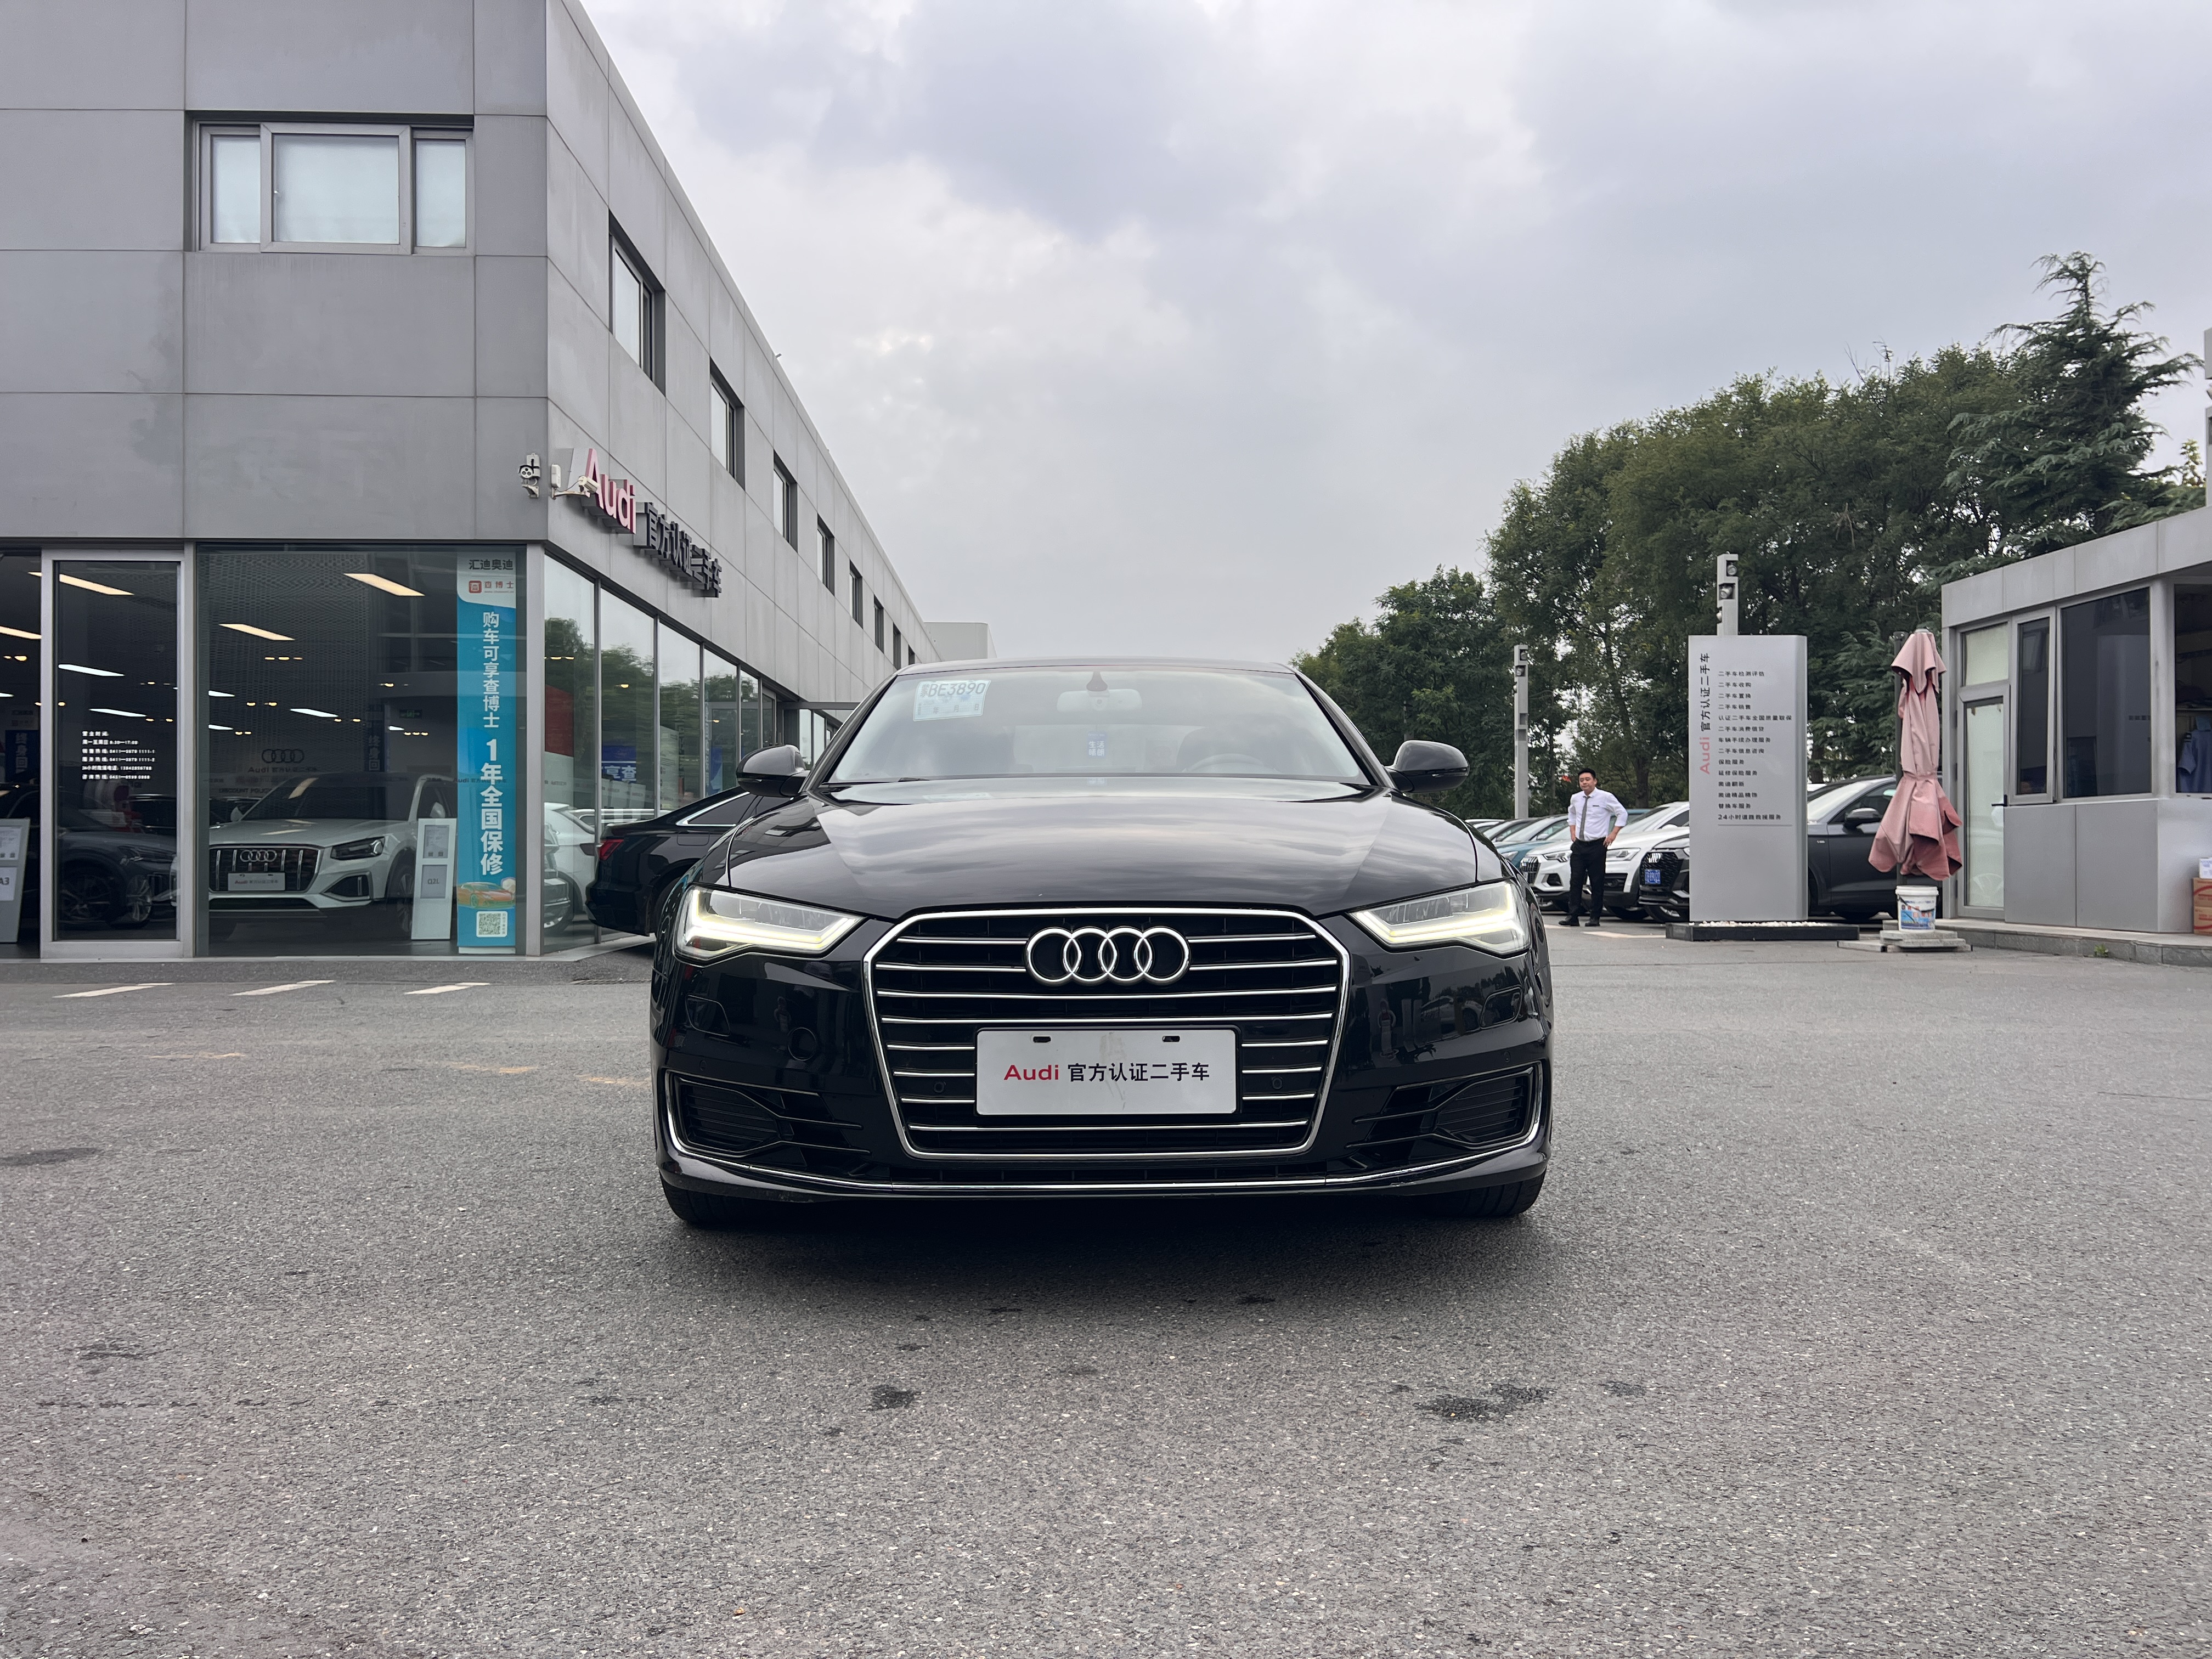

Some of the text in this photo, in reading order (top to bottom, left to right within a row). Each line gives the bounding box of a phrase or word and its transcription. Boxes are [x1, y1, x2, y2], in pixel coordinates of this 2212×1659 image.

[469, 559, 514, 570] 汇迪奥迪
[585, 448, 723, 598] Audi 官方认证二手车
[483, 611, 499, 729] 购车可享查博士
[1700, 653, 1711, 775] Audi 官方认证二手车
[481, 738, 503, 876] 1年全国保修
[1003, 1062, 1210, 1081] Audi 官方认证二手车
